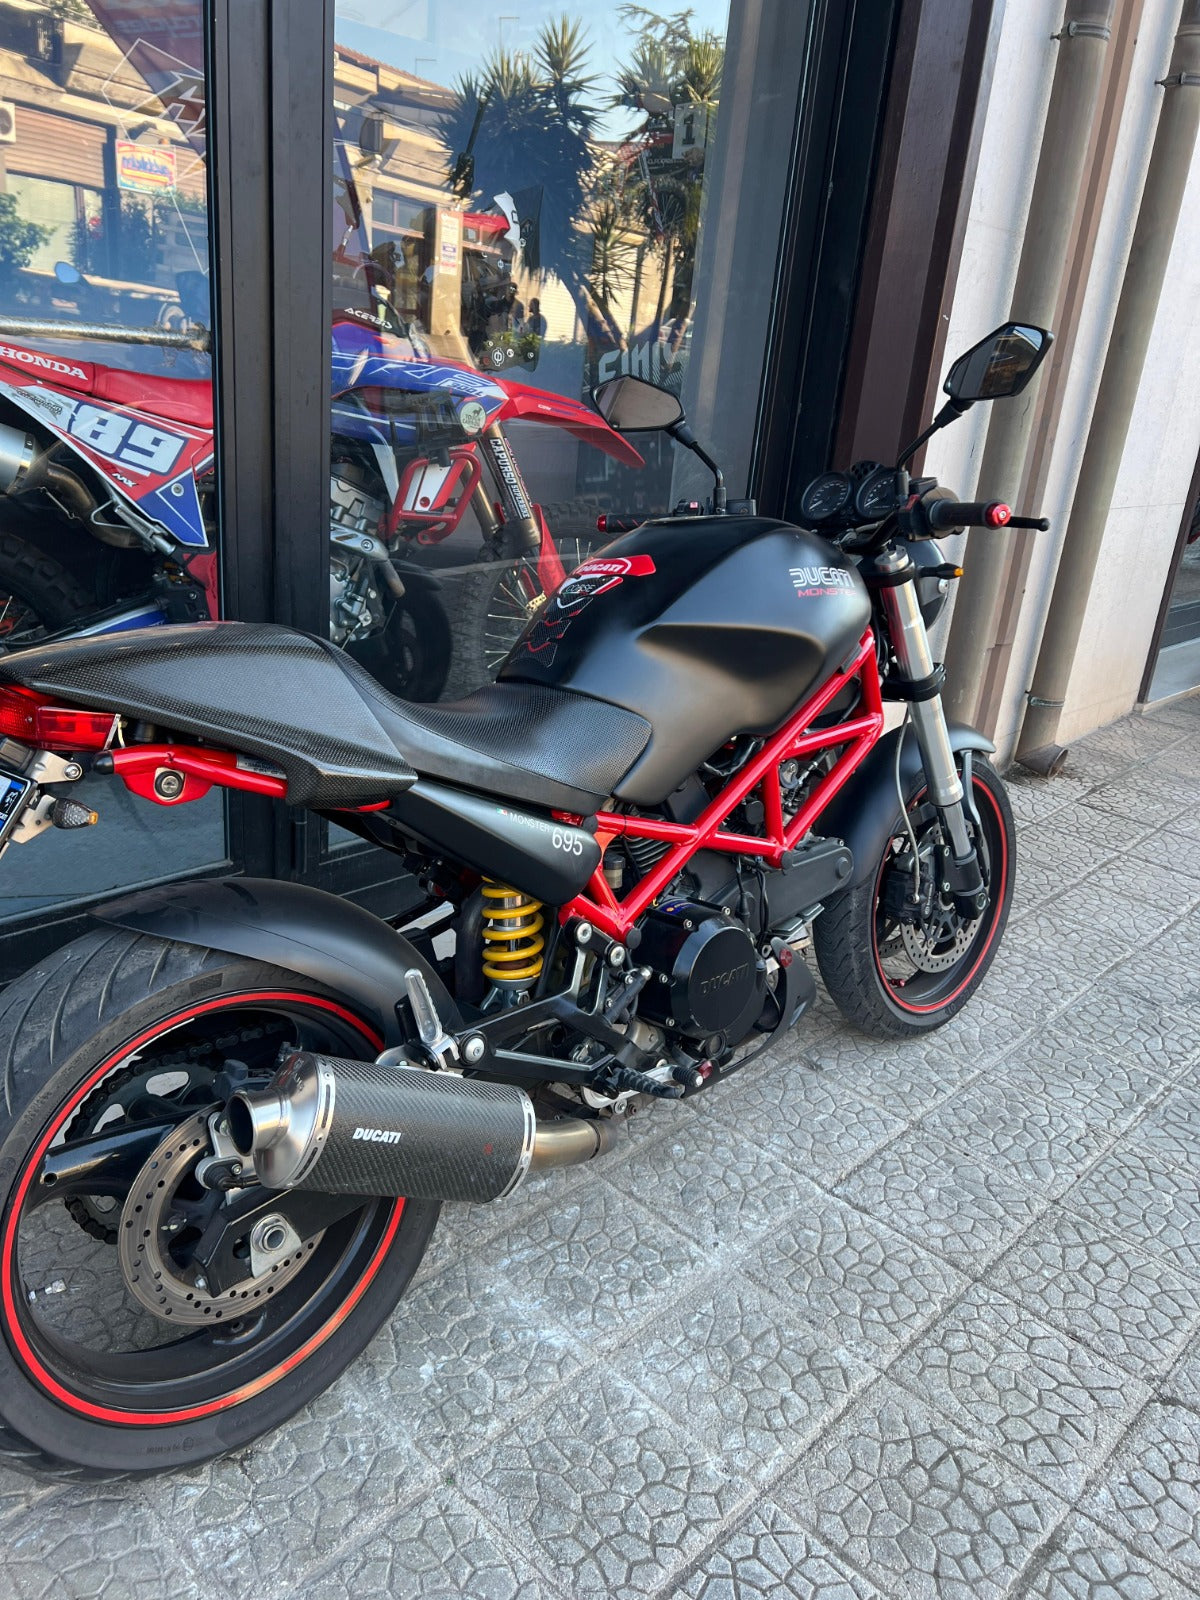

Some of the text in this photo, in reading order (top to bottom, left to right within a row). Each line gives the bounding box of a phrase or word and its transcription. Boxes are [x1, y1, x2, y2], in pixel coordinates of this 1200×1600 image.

[0, 346, 89, 380] HONDA
[490, 438, 517, 485] CAPURSO
[579, 563, 625, 573] DUCATI
[788, 566, 855, 588] DUCATI
[509, 812, 583, 856] MONSTER 695
[700, 963, 749, 994] DUCATI
[352, 1127, 402, 1144] DUCATI
